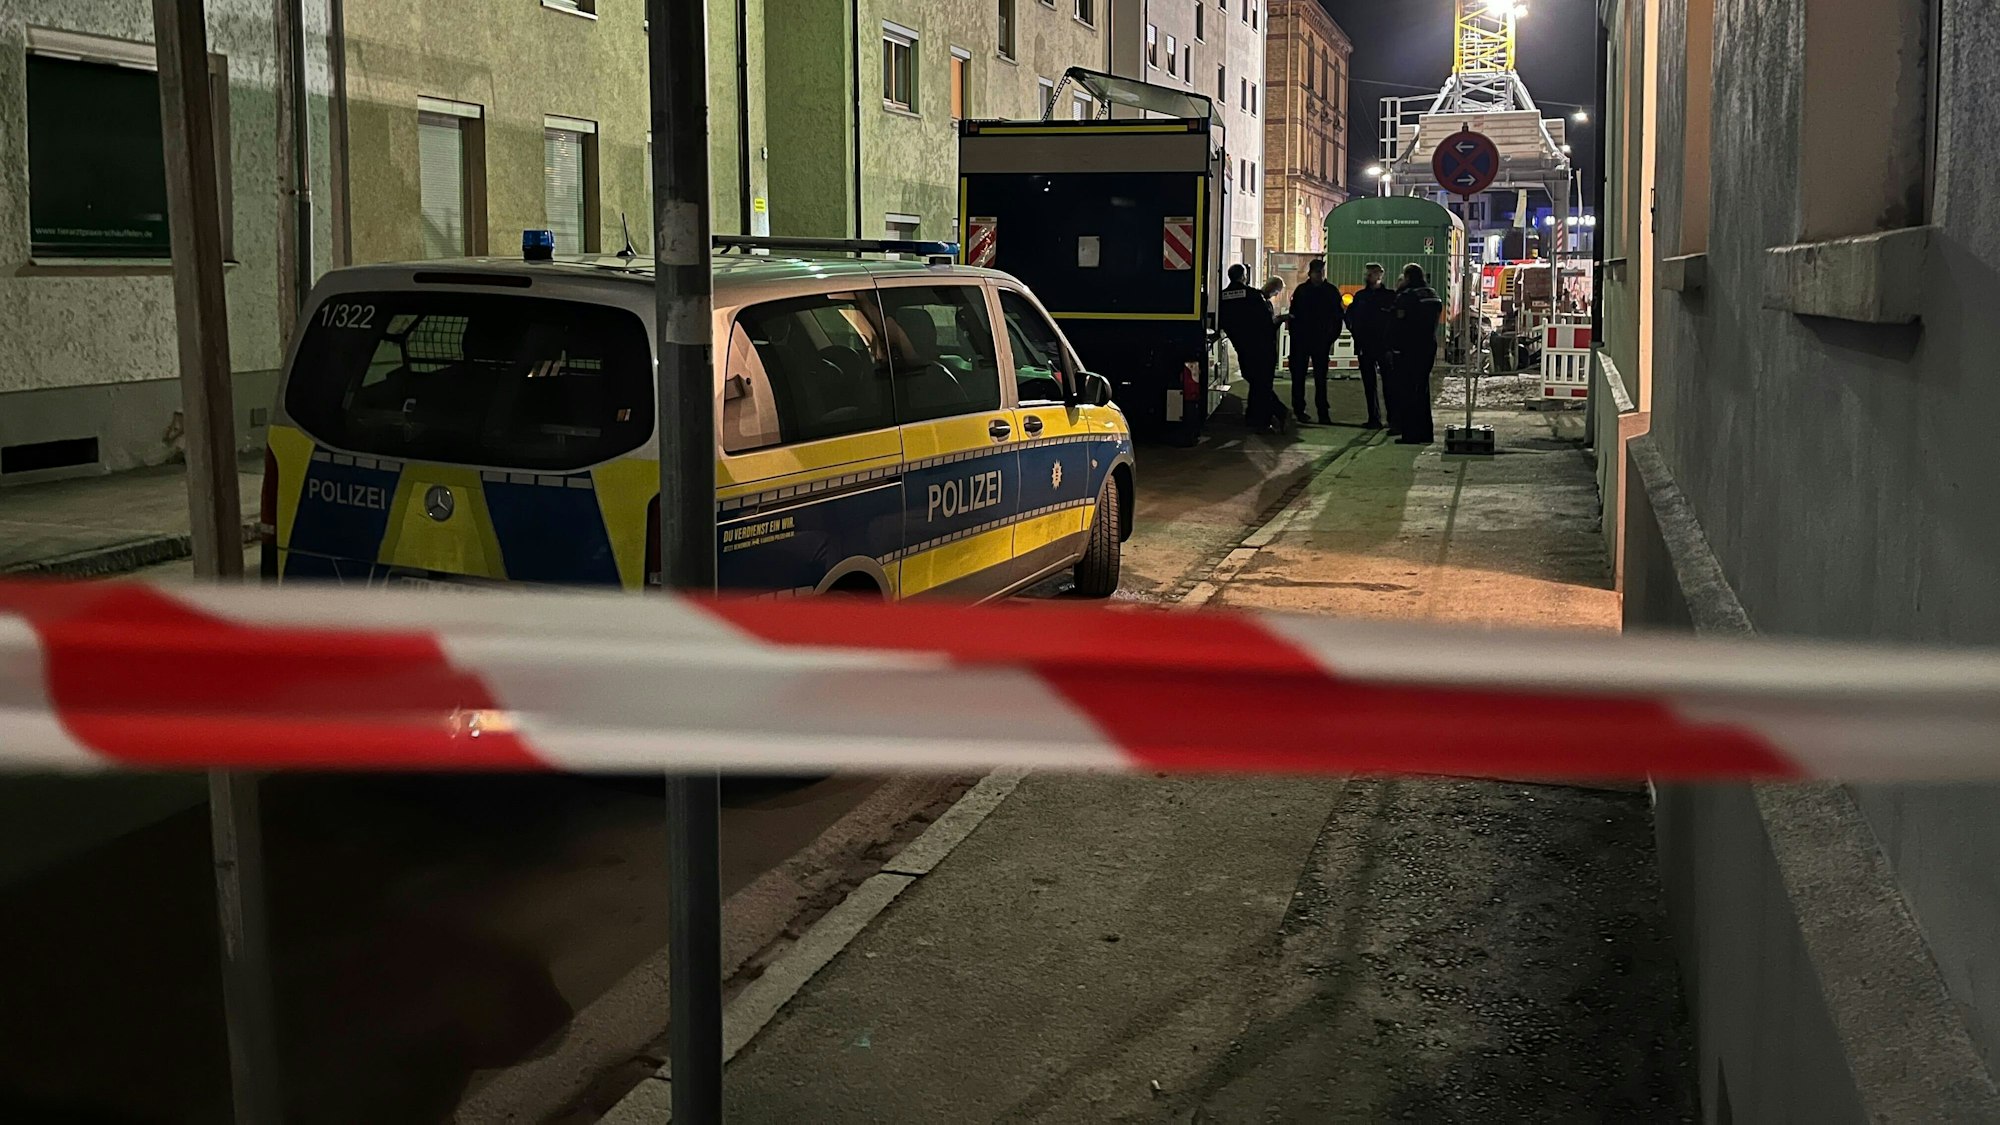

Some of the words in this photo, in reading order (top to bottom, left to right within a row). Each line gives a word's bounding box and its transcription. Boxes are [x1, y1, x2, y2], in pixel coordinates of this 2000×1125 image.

[320, 303, 376, 329] 1/322
[308, 478, 386, 510] POLIZEI
[927, 469, 1002, 522] POLIZEI
[723, 530, 733, 543] DU
[734, 522, 769, 540] VERDIENST
[769, 519, 780, 532] EIN
[781, 516, 795, 530] WIR.
